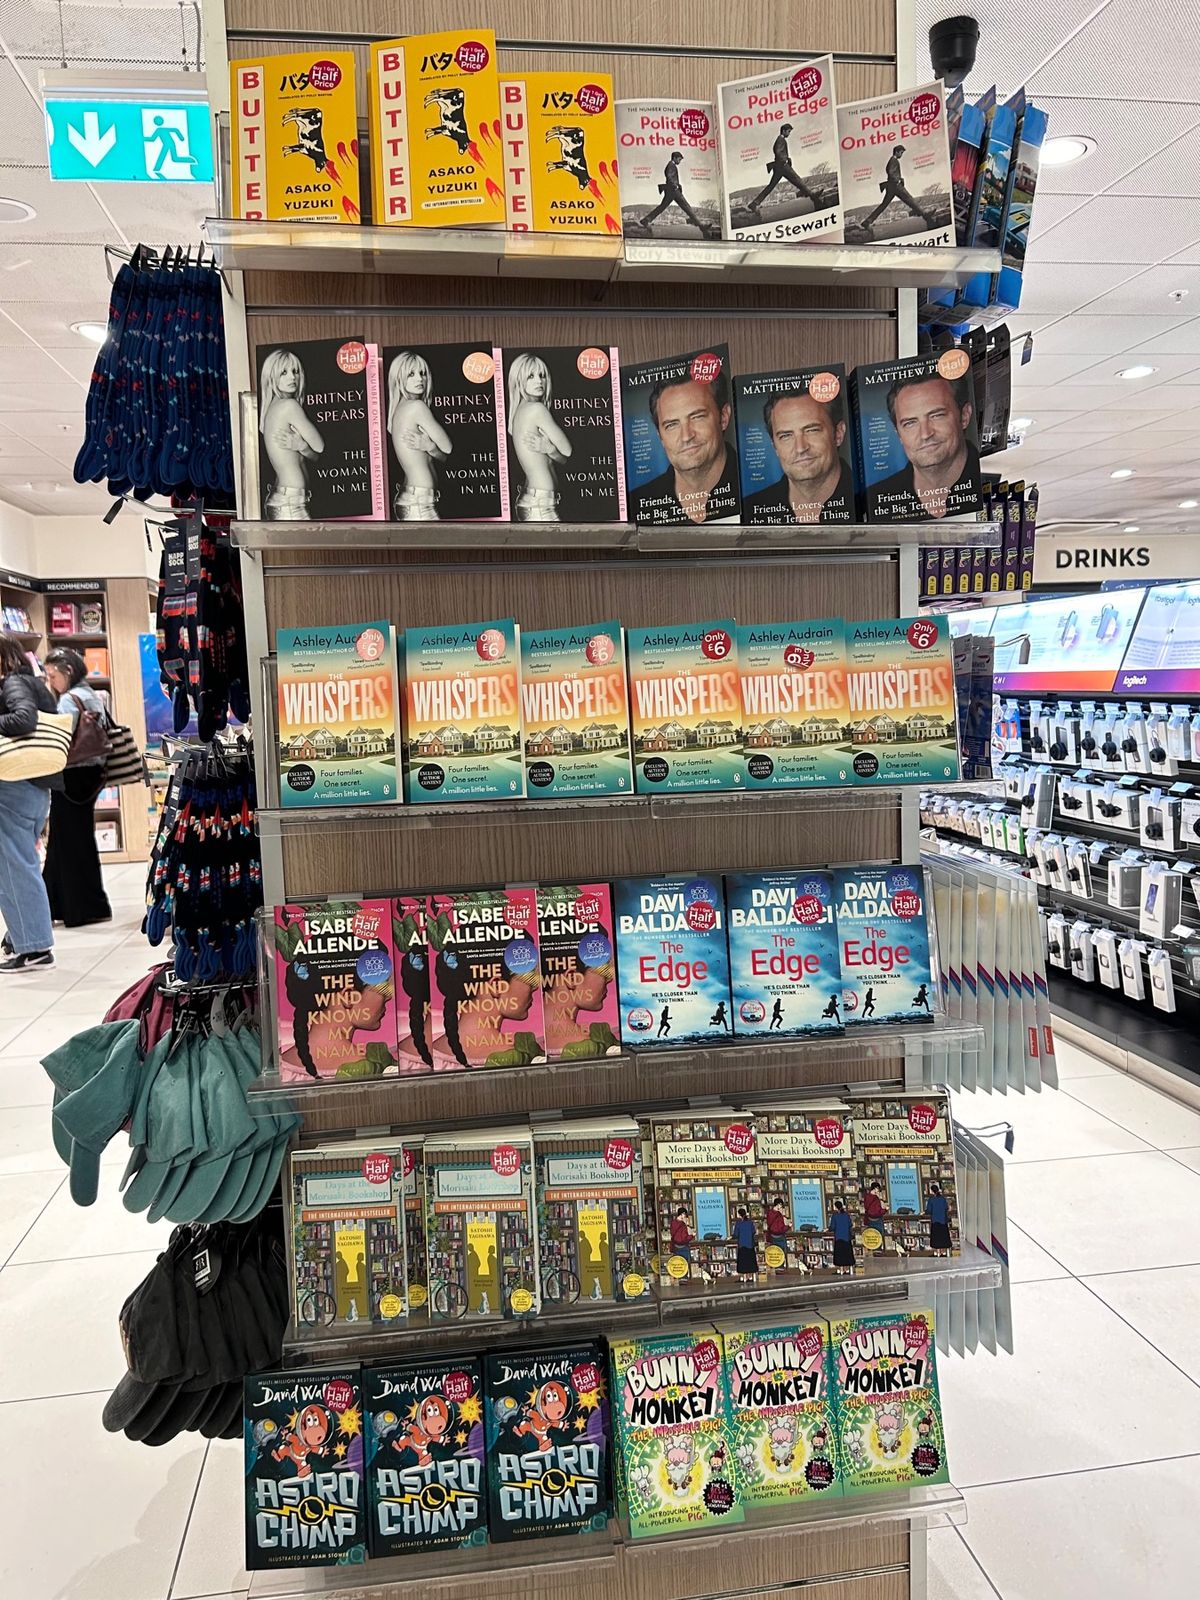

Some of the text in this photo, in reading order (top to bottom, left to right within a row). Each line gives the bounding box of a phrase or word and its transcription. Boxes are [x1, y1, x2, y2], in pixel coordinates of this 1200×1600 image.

[420, 52, 453, 72] バタ
[458, 52, 485, 63] Half
[461, 61, 481, 70] Price
[312, 71, 339, 82] Half
[793, 73, 818, 93] Half
[314, 80, 334, 88] Price
[748, 88, 791, 109] Politi
[799, 86, 818, 98] Price
[728, 96, 828, 130] On the Edge
[383, 54, 406, 215] BUTTER
[841, 137, 866, 150] On
[869, 128, 896, 145] the
[901, 119, 941, 139] Edge
[621, 133, 716, 151] On the Edge
[429, 166, 475, 178] ASAKO
[285, 183, 331, 194] ASAKO
[427, 181, 477, 194] YUZUKI
[284, 200, 333, 210] YUZUKI
[775, 213, 837, 239] Stewart
[340, 352, 365, 363] Half
[369, 354, 377, 368] THE
[629, 367, 687, 386] MATTHEW
[865, 368, 924, 385] MATTHEW
[307, 390, 364, 406] BRITNEY
[435, 394, 492, 407] BRITNEY
[317, 408, 365, 423] SPEARS
[445, 412, 493, 424] SPEARS
[344, 451, 367, 460] THE
[472, 453, 495, 462] THE
[317, 466, 368, 478] WOMAN
[446, 469, 496, 479] WOMAN
[332, 483, 368, 493] IN ME
[461, 484, 496, 494] IN ME
[877, 480, 972, 503] Friends, Lovers, and
[640, 483, 731, 508] Friends, Lovers, and
[637, 496, 736, 520] the Big Terrible Thing
[874, 492, 977, 516] the Big Terrible Thing
[1056, 548, 1150, 569] DRINKS
[292, 634, 332, 648] Ashley
[643, 633, 679, 647] Ashley
[705, 632, 725, 642] Only
[749, 627, 833, 643] Ashley Audrain
[708, 642, 725, 656] £6
[635, 672, 737, 719] WHISPERS
[741, 669, 844, 715] WHISPERS
[848, 667, 949, 712] WHISPERS
[283, 675, 389, 725] WHISPERS
[412, 674, 515, 722] WHISPERS
[337, 769, 364, 777] families.
[320, 791, 342, 799] million
[640, 893, 685, 913] DAVI
[689, 912, 713, 922] Half
[304, 918, 353, 935] ISABE
[355, 919, 379, 931] Half
[691, 921, 709, 929] Price
[356, 930, 375, 938] Price
[443, 926, 525, 944] ALLENDE
[293, 937, 379, 955] ALLENDE
[660, 942, 683, 954] The
[772, 935, 795, 948] The
[639, 956, 708, 988] Edge
[751, 949, 820, 982] Edge
[321, 974, 354, 990] THE
[315, 991, 362, 1007] WIND
[308, 1008, 371, 1025] KNOWS
[328, 1027, 352, 1040] MY
[317, 1044, 366, 1059] NAME
[911, 1114, 934, 1125] Half
[862, 1123, 909, 1132] More Days
[913, 1123, 930, 1131] Price
[728, 1135, 750, 1146] Half
[859, 1132, 941, 1142] Morisaki Bookshop
[668, 1144, 716, 1153] More Days
[567, 1161, 586, 1171] Days
[665, 1154, 748, 1164] Morisaki Bookshop
[552, 1171, 629, 1181] Morisaki Bookshop
[602, 1189, 631, 1197] BESTSELLER
[695, 1350, 716, 1365] Half
[701, 1360, 717, 1370] Price
[493, 1361, 537, 1385] David
[627, 1356, 713, 1396] BUNNY
[844, 1360, 923, 1393] MONKEY
[253, 1384, 299, 1407] David
[326, 1389, 350, 1401] Half
[631, 1387, 714, 1425] MONKEY
[498, 1444, 599, 1482] ASTRO
[255, 1471, 360, 1507] ASTRO
[500, 1483, 597, 1520] CHIMP
[649, 1507, 689, 1519] INTRODUCING
[256, 1512, 356, 1549] CHIMP
